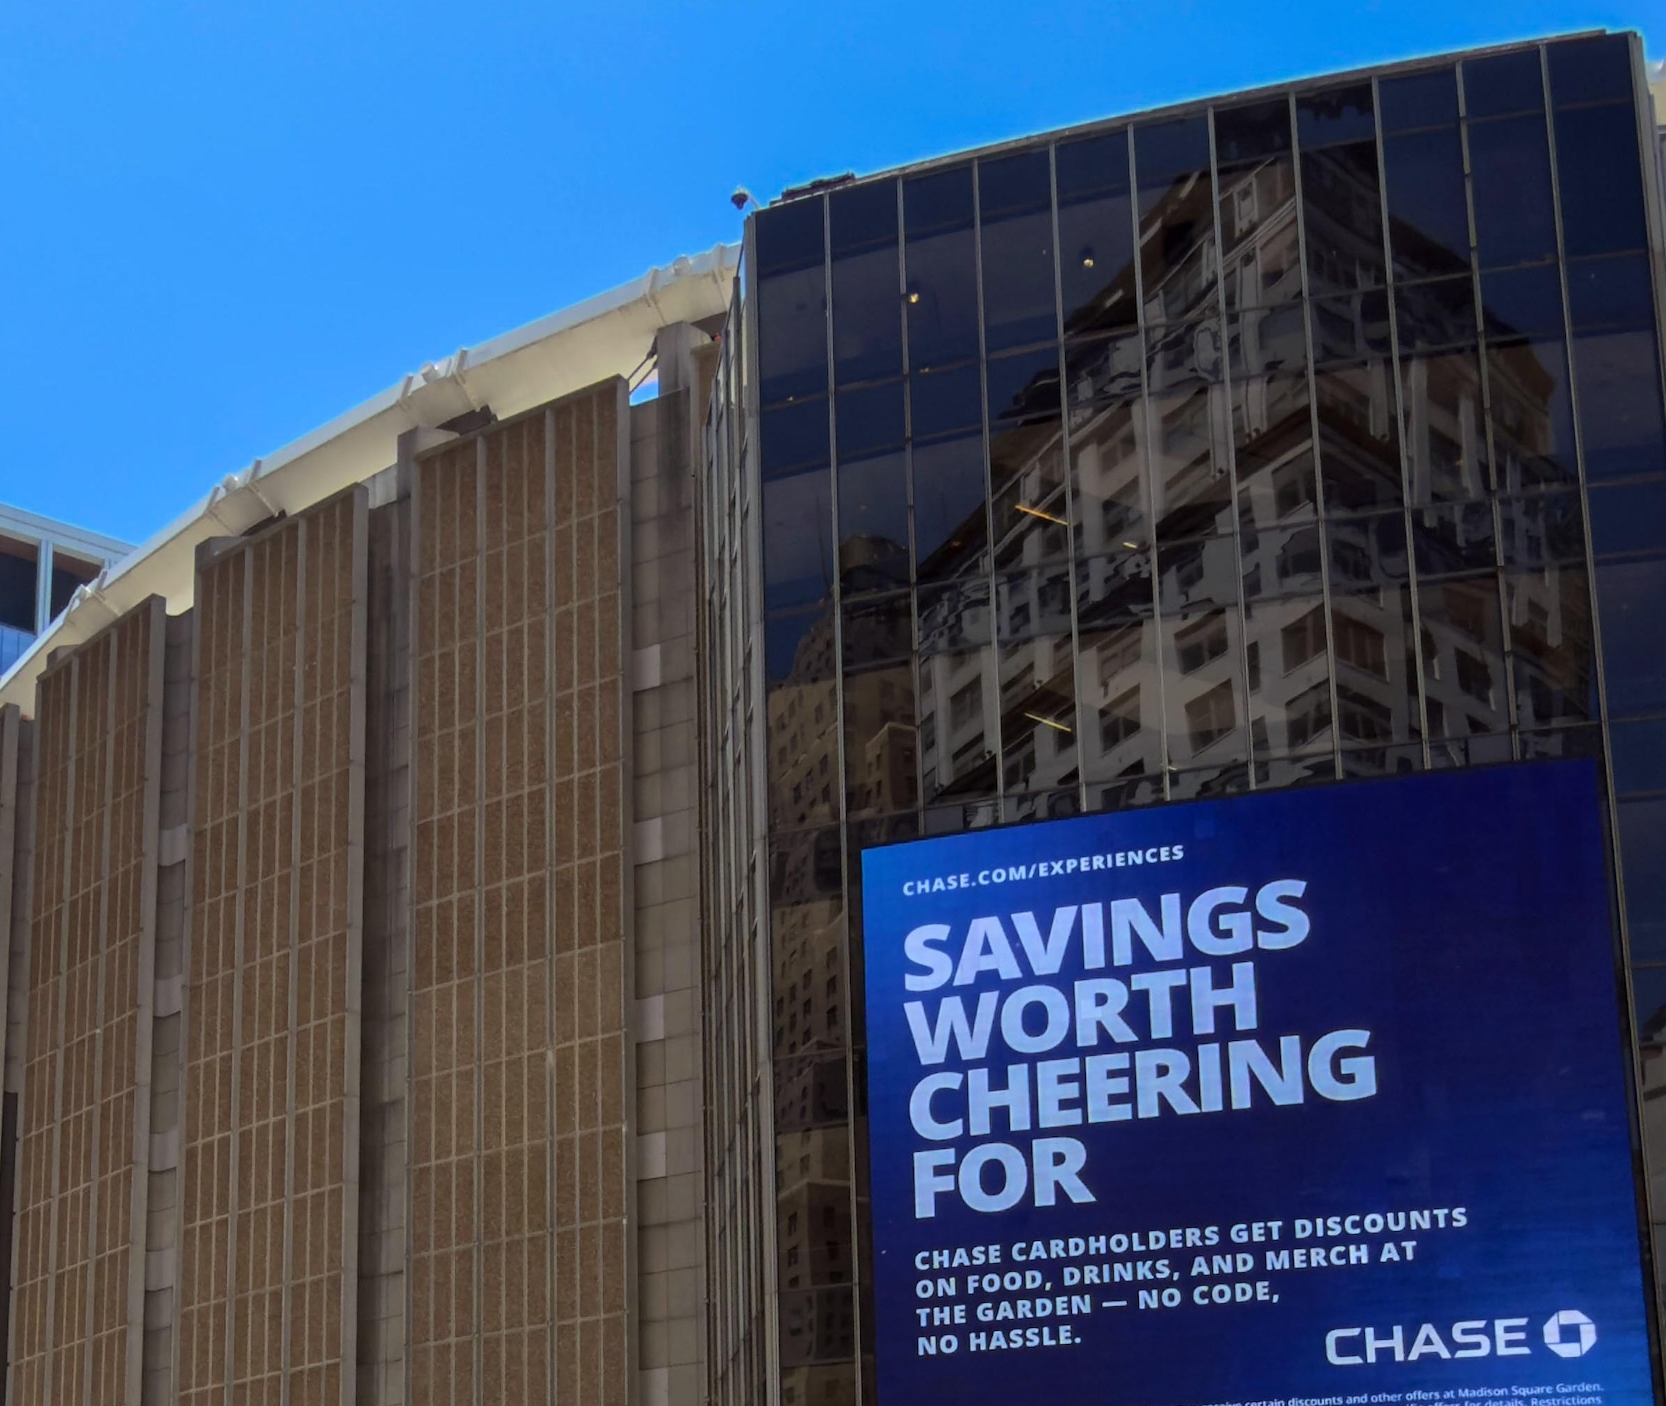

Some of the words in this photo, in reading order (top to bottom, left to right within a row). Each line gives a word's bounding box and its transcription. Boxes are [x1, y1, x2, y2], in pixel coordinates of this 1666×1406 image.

[903, 845, 1183, 895] CHASE.COM/EXPERIENCES
[904, 879, 1311, 991] SAVINGS
[904, 961, 1257, 1065] WORTH
[909, 1029, 1377, 1140] CHEERING
[914, 1137, 1096, 1218] FOR
[915, 1244, 1001, 1269] CHASE
[1011, 1226, 1219, 1260] CARDHOLDERS
[1230, 1221, 1282, 1242] GET
[1294, 1207, 1467, 1238] DISCOUNTS
[915, 1277, 955, 1297] ON
[967, 1270, 1051, 1293] FOOD,
[1063, 1259, 1179, 1285] DRINKS,
[1190, 1253, 1253, 1275] AND
[1265, 1244, 1368, 1270] MERCH
[1379, 1240, 1416, 1261] AT
[915, 1304, 966, 1326] THE
[976, 1294, 1091, 1321] GARDEN
[1138, 1288, 1181, 1308] NO
[1193, 1281, 1279, 1304] CODE,
[917, 1334, 957, 1355] NO
[969, 1325, 1081, 1351] HASSLE.
[1327, 1318, 1531, 1366] CHASE
[1287, 1396, 1343, 1406] discounts
[1345, 1393, 1367, 1404] and
[1370, 1392, 1401, 1402] other
[1405, 1390, 1439, 1400] offers
[1443, 1390, 1454, 1398] at
[1458, 1387, 1507, 1397] Madison
[1511, 1385, 1552, 1396] Square
[1555, 1382, 1604, 1392] Garden.
[1531, 1396, 1601, 1406] Restrictions
